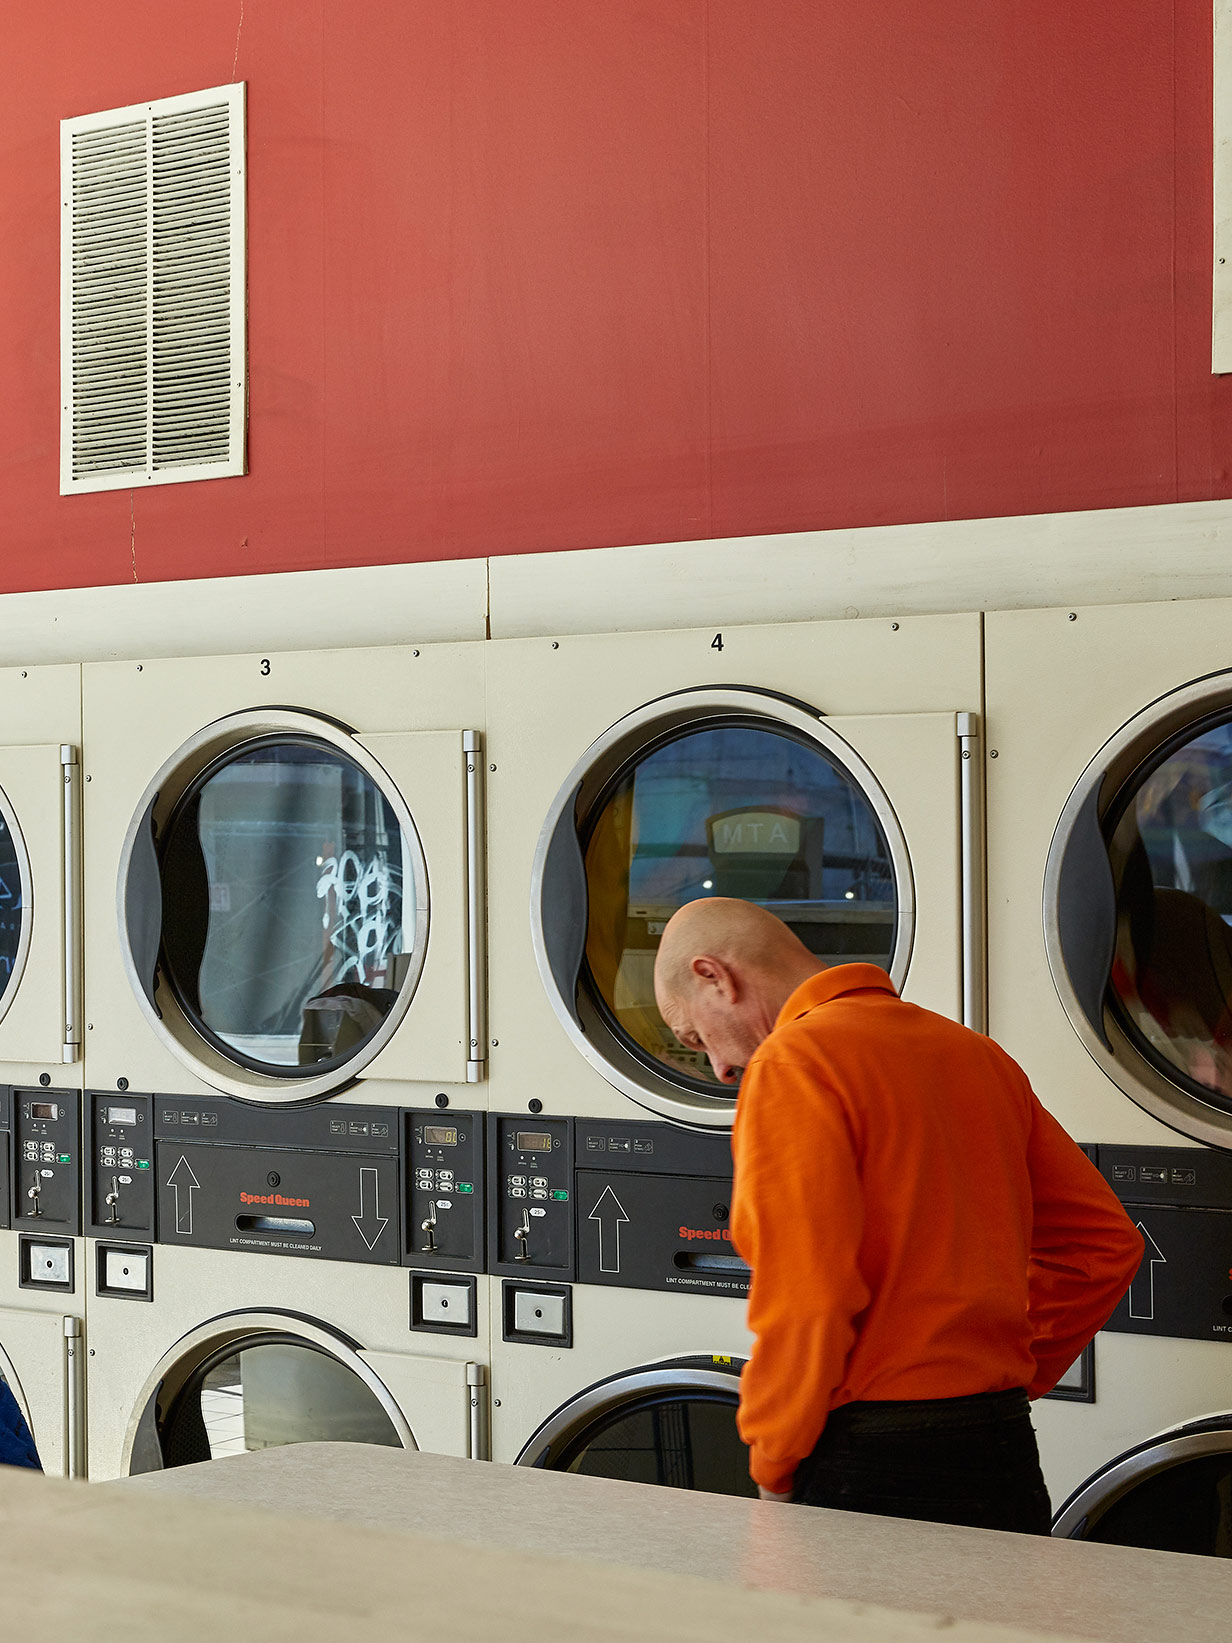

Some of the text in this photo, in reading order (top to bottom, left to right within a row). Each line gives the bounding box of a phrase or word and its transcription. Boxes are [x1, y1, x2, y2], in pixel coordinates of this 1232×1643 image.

[710, 633, 725, 652] 4
[260, 658, 271, 676] 3
[240, 1191, 310, 1208] Speed Queen
[679, 1226, 721, 1241] Speed
[239, 1238, 270, 1247] COMPARTMENT
[678, 1278, 716, 1287] COMPARTMENT
